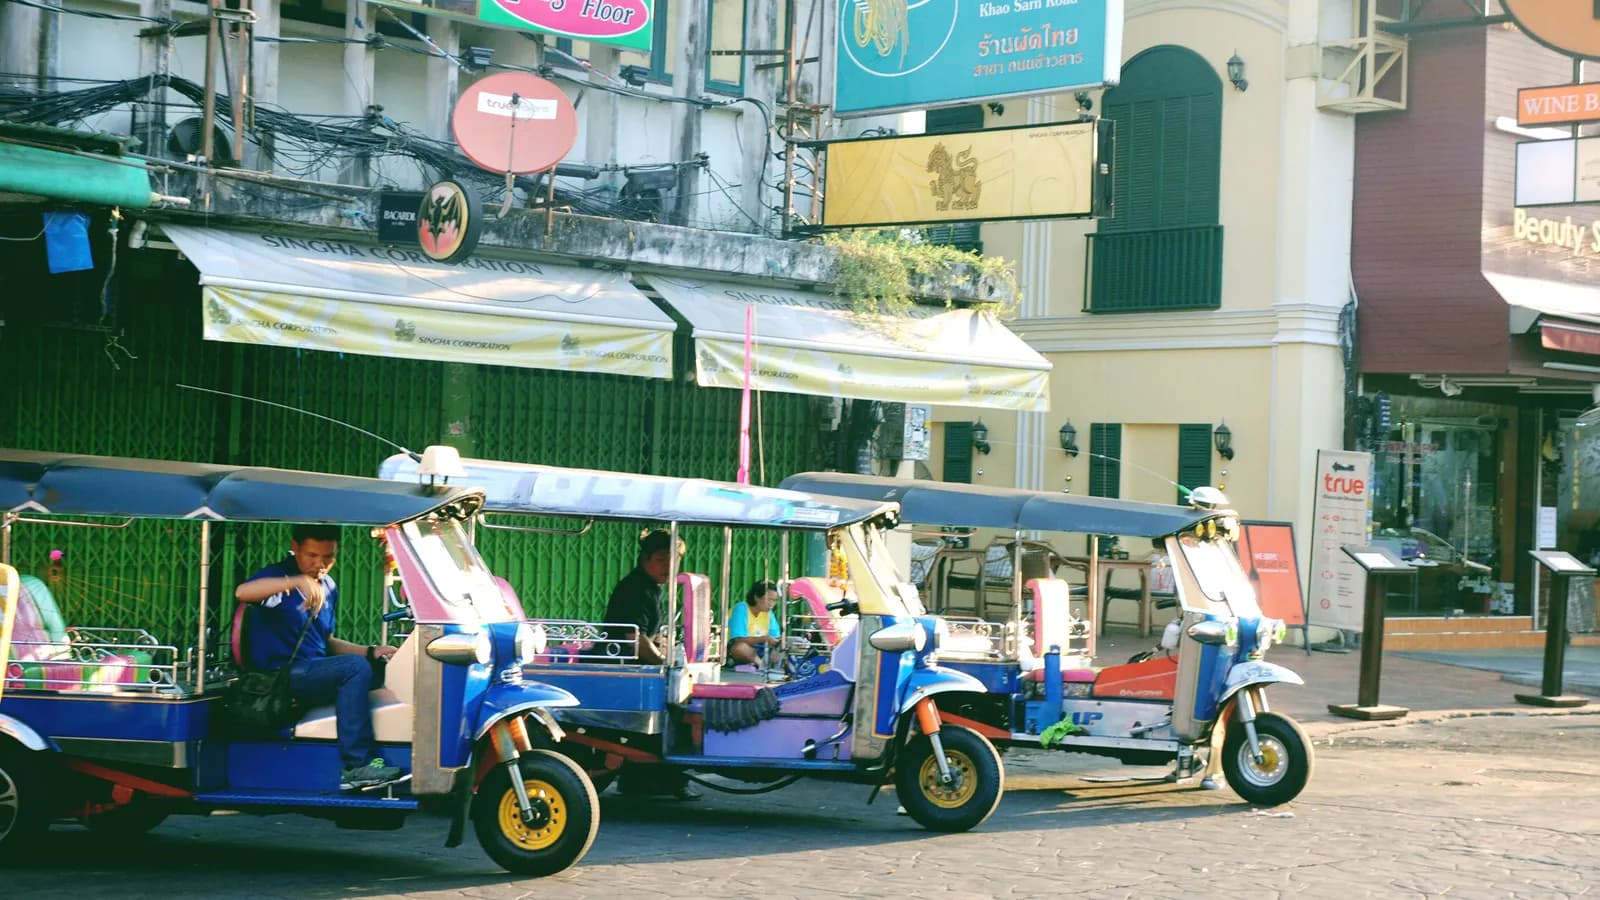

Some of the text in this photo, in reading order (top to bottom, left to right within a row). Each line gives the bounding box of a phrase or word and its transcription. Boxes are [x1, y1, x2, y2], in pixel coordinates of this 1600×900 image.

[582, 0, 633, 24] Floor
[979, 3, 1010, 17] Khao
[978, 22, 1079, 57] ร้านผัดไทย
[1524, 92, 1600, 116] WINE B
[1514, 207, 1585, 256] Beauty
[261, 235, 366, 257] SINGHA
[1324, 472, 1365, 496] true
